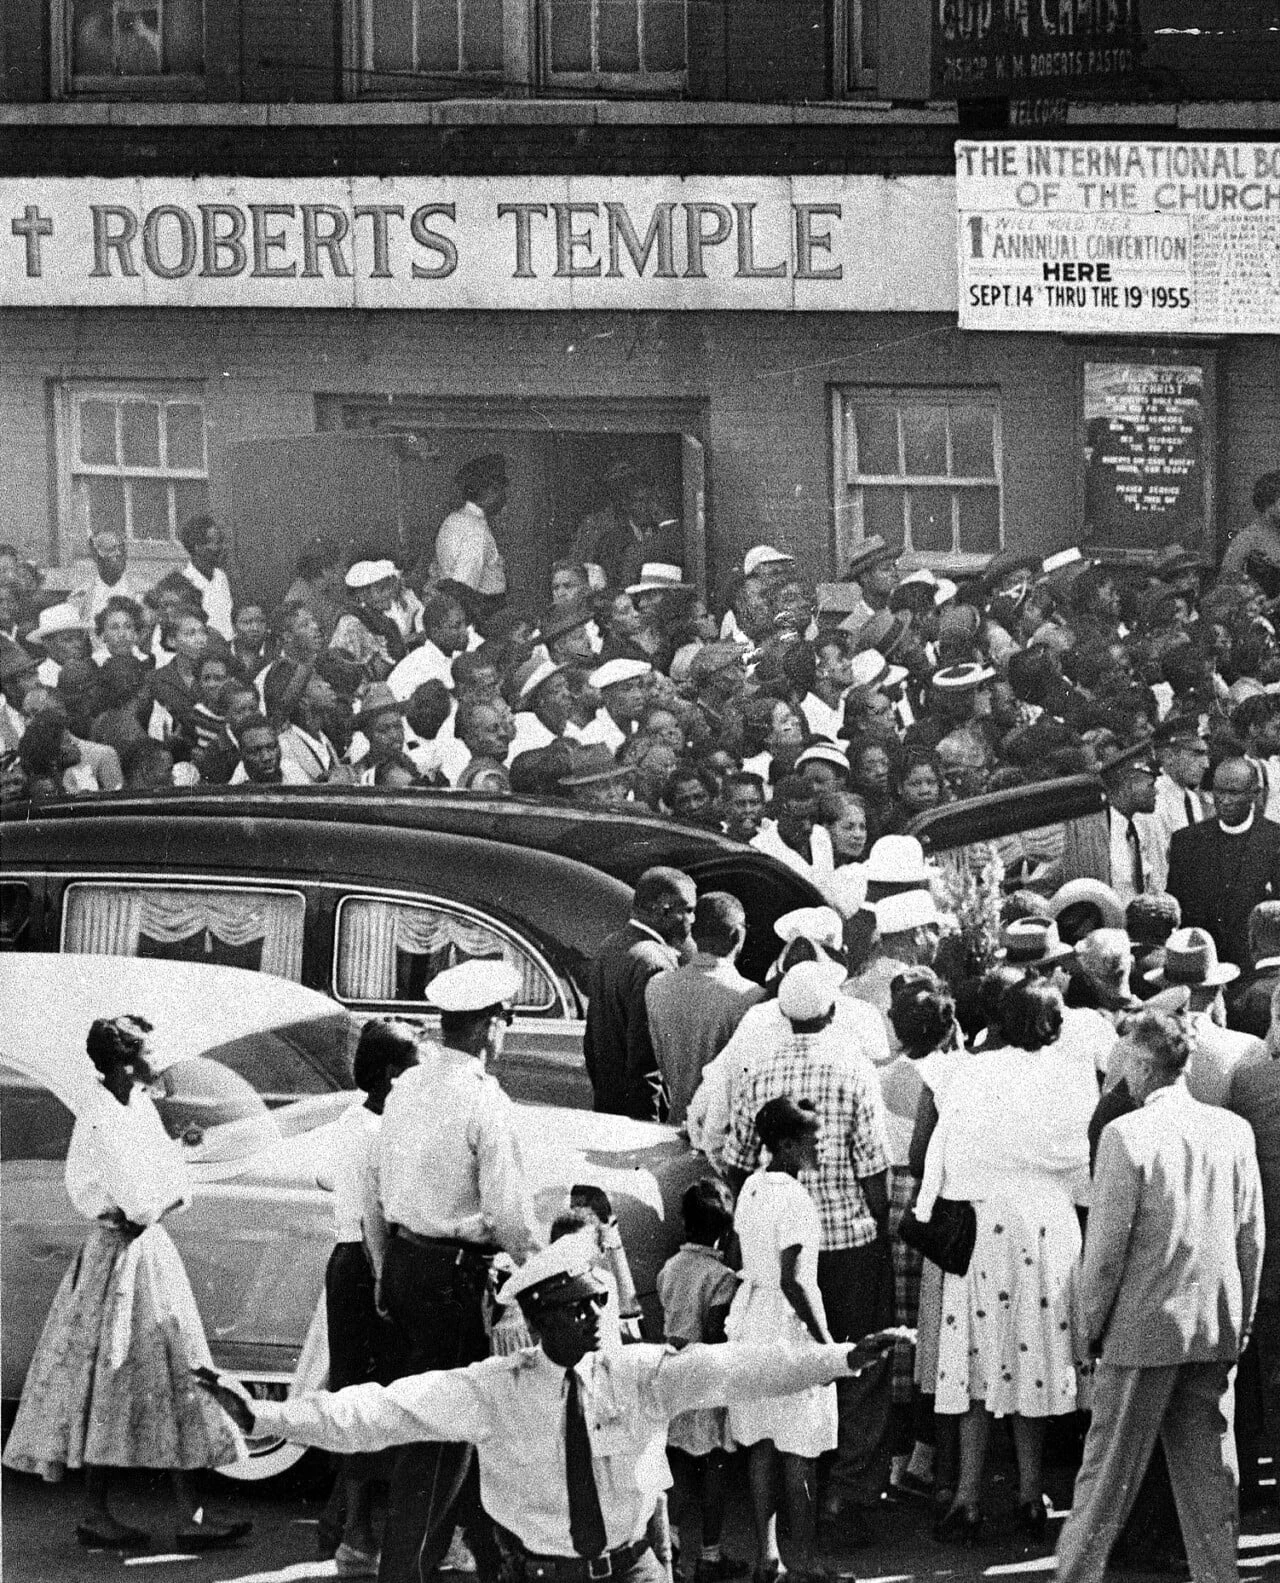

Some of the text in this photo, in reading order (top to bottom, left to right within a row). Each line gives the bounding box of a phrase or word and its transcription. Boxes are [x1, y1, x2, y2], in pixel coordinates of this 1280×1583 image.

[960, 145, 1018, 178] THE
[1026, 145, 1247, 179] INTERNATIONAL
[1016, 181, 1060, 208] OF
[1079, 182, 1137, 209] THE
[89, 201, 844, 280] ROBERTS TEMPLE
[992, 233, 1078, 260] ANNNUAL
[1086, 234, 1187, 261] CONVENTION
[1042, 263, 1113, 282] HERE
[1045, 286, 1086, 308] THRU
[1091, 286, 1119, 308] THE
